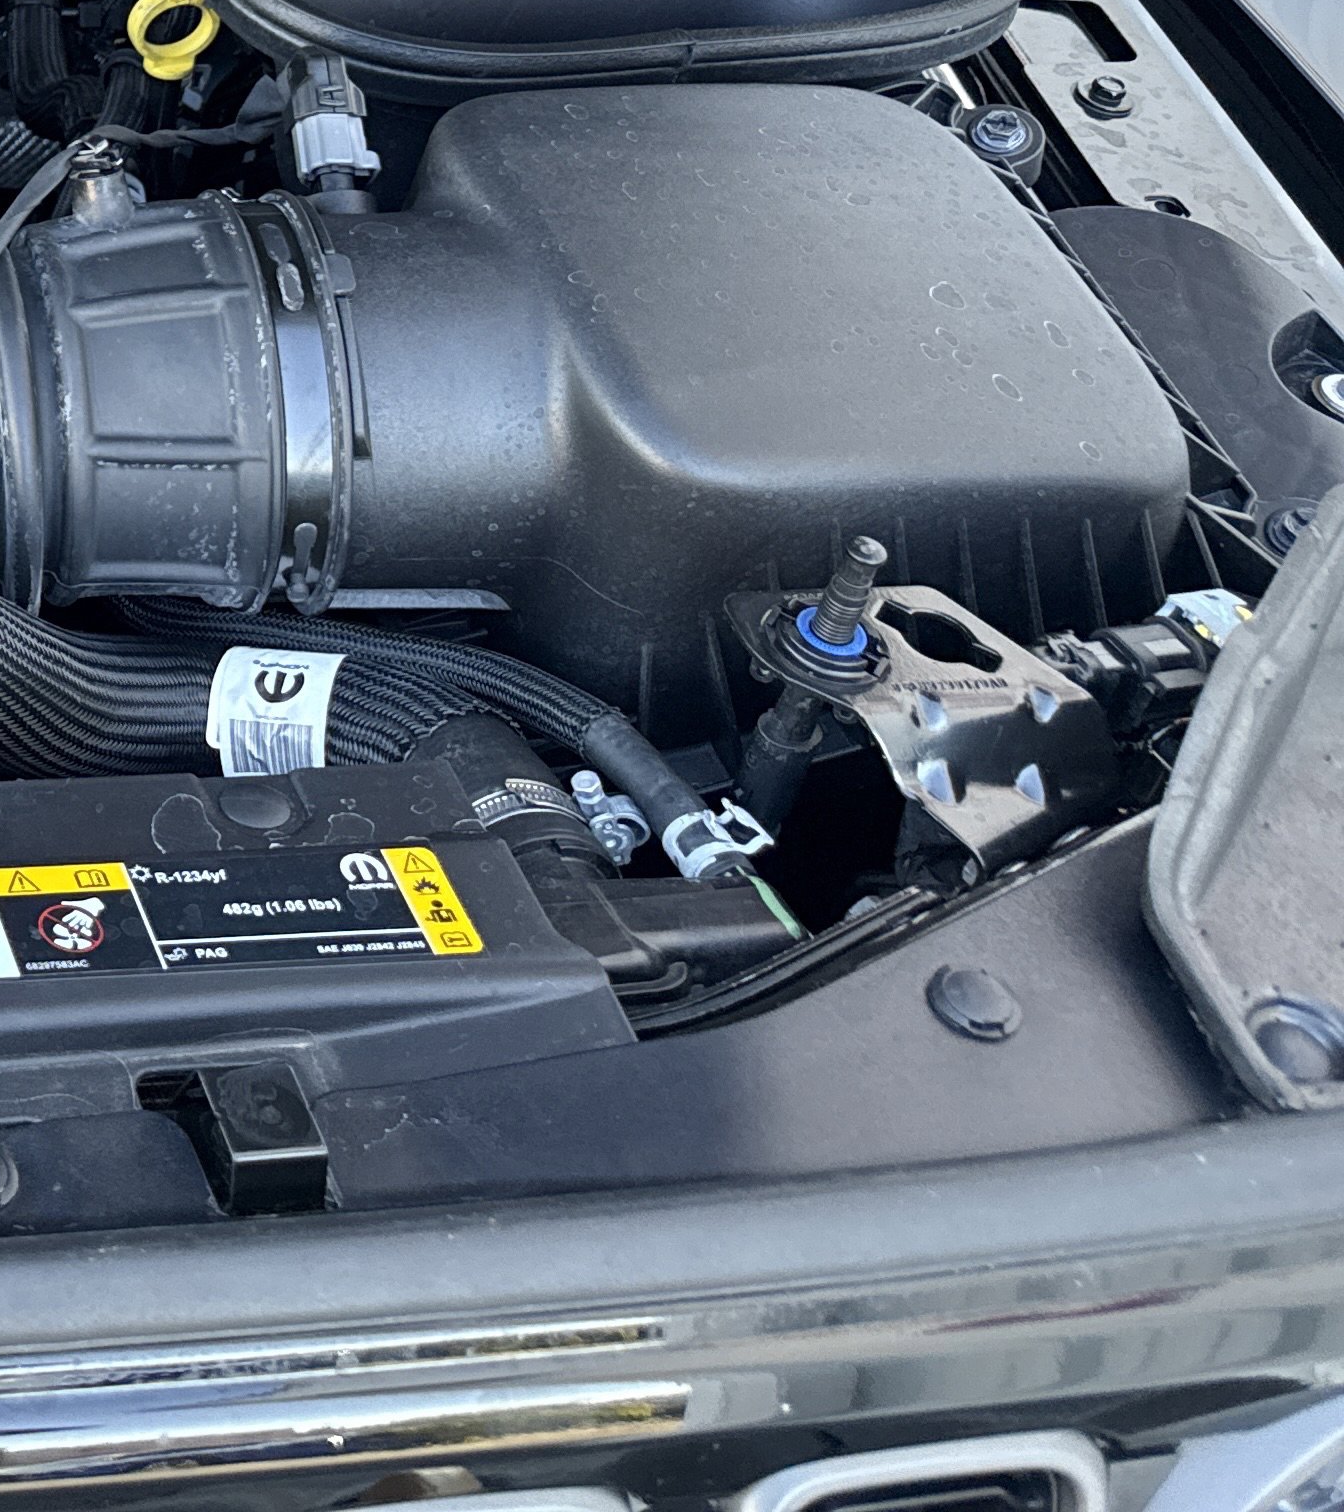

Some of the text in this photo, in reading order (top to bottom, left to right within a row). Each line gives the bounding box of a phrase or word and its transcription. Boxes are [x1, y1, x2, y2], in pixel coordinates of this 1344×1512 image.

[154, 869, 227, 885] R-1234yf
[223, 897, 342, 917] 482g (1.06 lbs)
[195, 947, 229, 959] PAG
